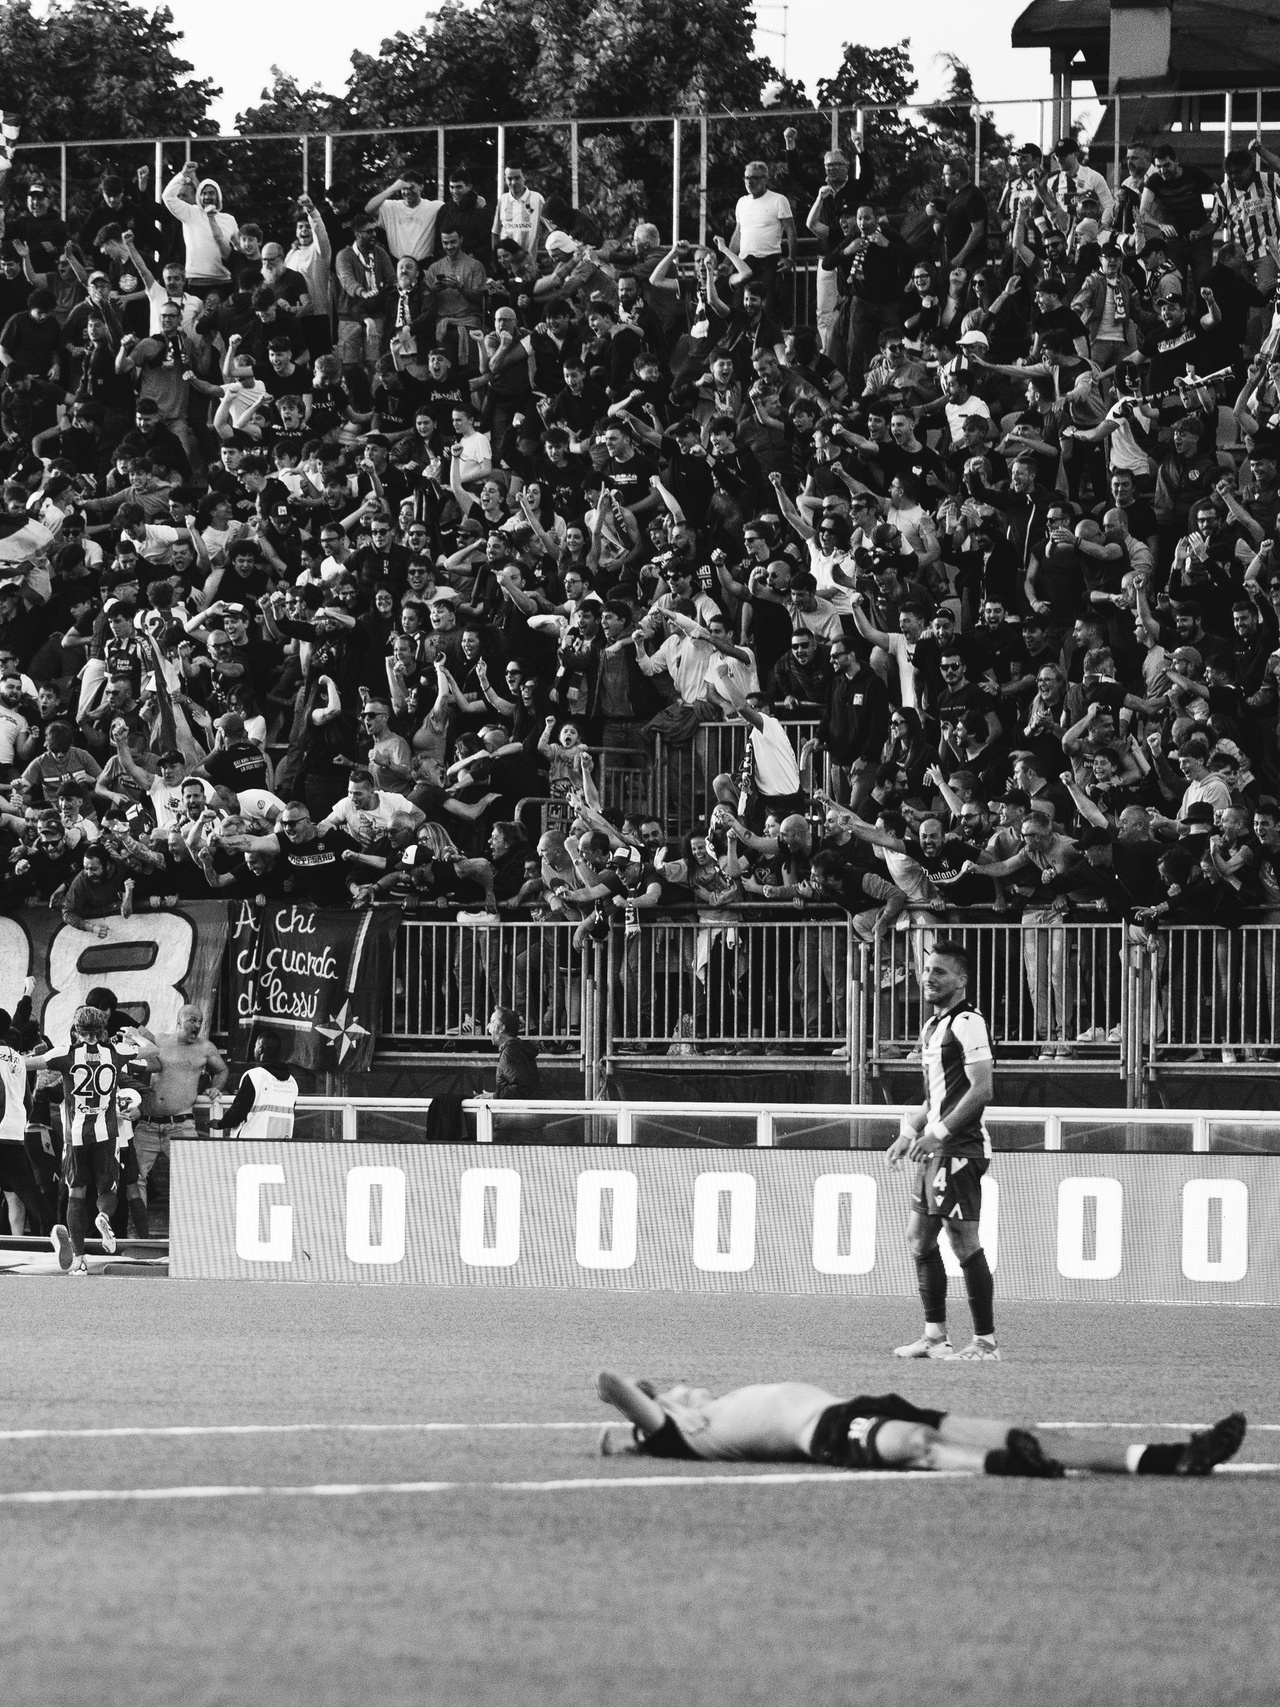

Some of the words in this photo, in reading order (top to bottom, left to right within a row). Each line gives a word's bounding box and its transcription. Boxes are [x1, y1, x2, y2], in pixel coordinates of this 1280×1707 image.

[233, 899, 261, 939] A
[275, 904, 316, 933] chi
[237, 939, 261, 975] ci
[260, 945, 339, 988] guarda
[69, 1063, 117, 1099] 20
[932, 1166, 947, 1192] 4
